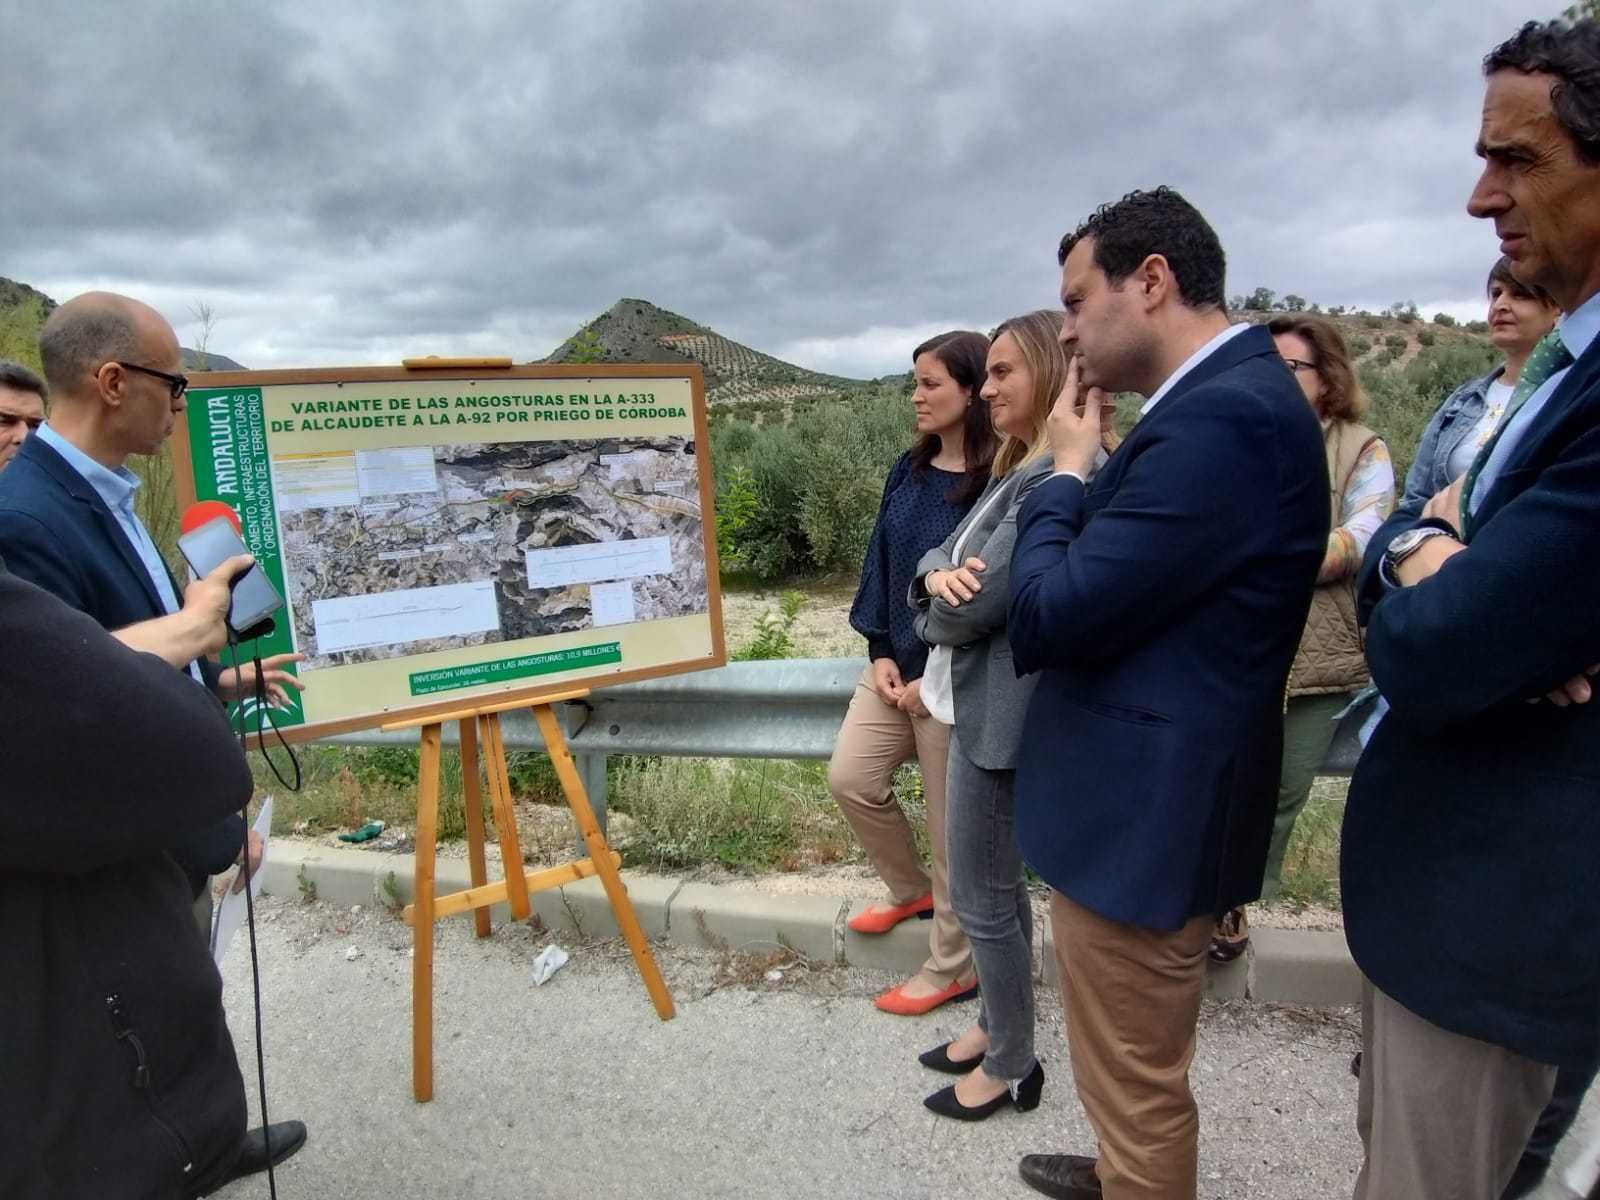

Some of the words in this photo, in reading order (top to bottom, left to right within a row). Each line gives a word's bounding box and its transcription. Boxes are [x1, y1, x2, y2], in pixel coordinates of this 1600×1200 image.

[291, 399, 383, 414] VARIANTE
[389, 398, 411, 410] DE
[417, 397, 449, 409] LAS
[454, 394, 564, 409] ANGOSTURAS
[569, 394, 589, 405] EN
[594, 393, 610, 405] LA
[617, 393, 655, 405] A-333
[247, 393, 265, 457] TERRITORIO
[271, 420, 294, 433] DE
[301, 415, 407, 431] ALCAUDETE
[412, 414, 424, 426] A
[430, 413, 450, 425] LA
[456, 412, 491, 424] A-92
[496, 411, 528, 423] POR
[534, 409, 590, 422] PRIEGO
[595, 409, 614, 420] DE
[233, 394, 256, 502] INFRAESTRUCTURAS
[254, 459, 268, 480] DEL
[256, 481, 276, 549] ORDENACIÓN
[265, 551, 277, 559] Y
[490, 663, 502, 672] DE
[502, 661, 517, 670] LAS
